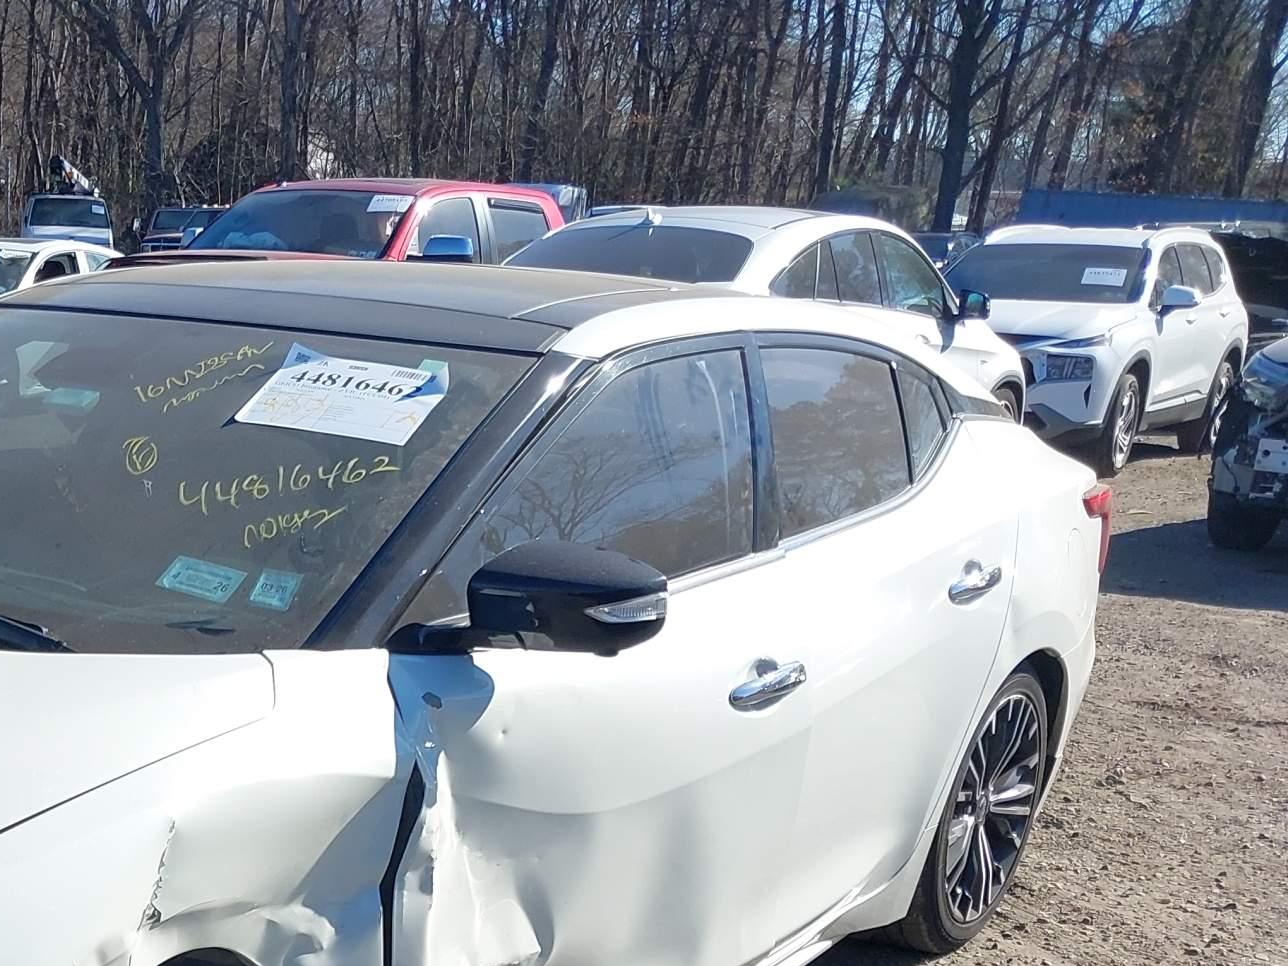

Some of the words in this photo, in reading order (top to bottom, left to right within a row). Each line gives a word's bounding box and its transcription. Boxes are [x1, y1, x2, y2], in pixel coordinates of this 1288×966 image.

[290, 369, 424, 399] 44816462
[178, 455, 401, 516] 44816462
[212, 581, 230, 593] 26
